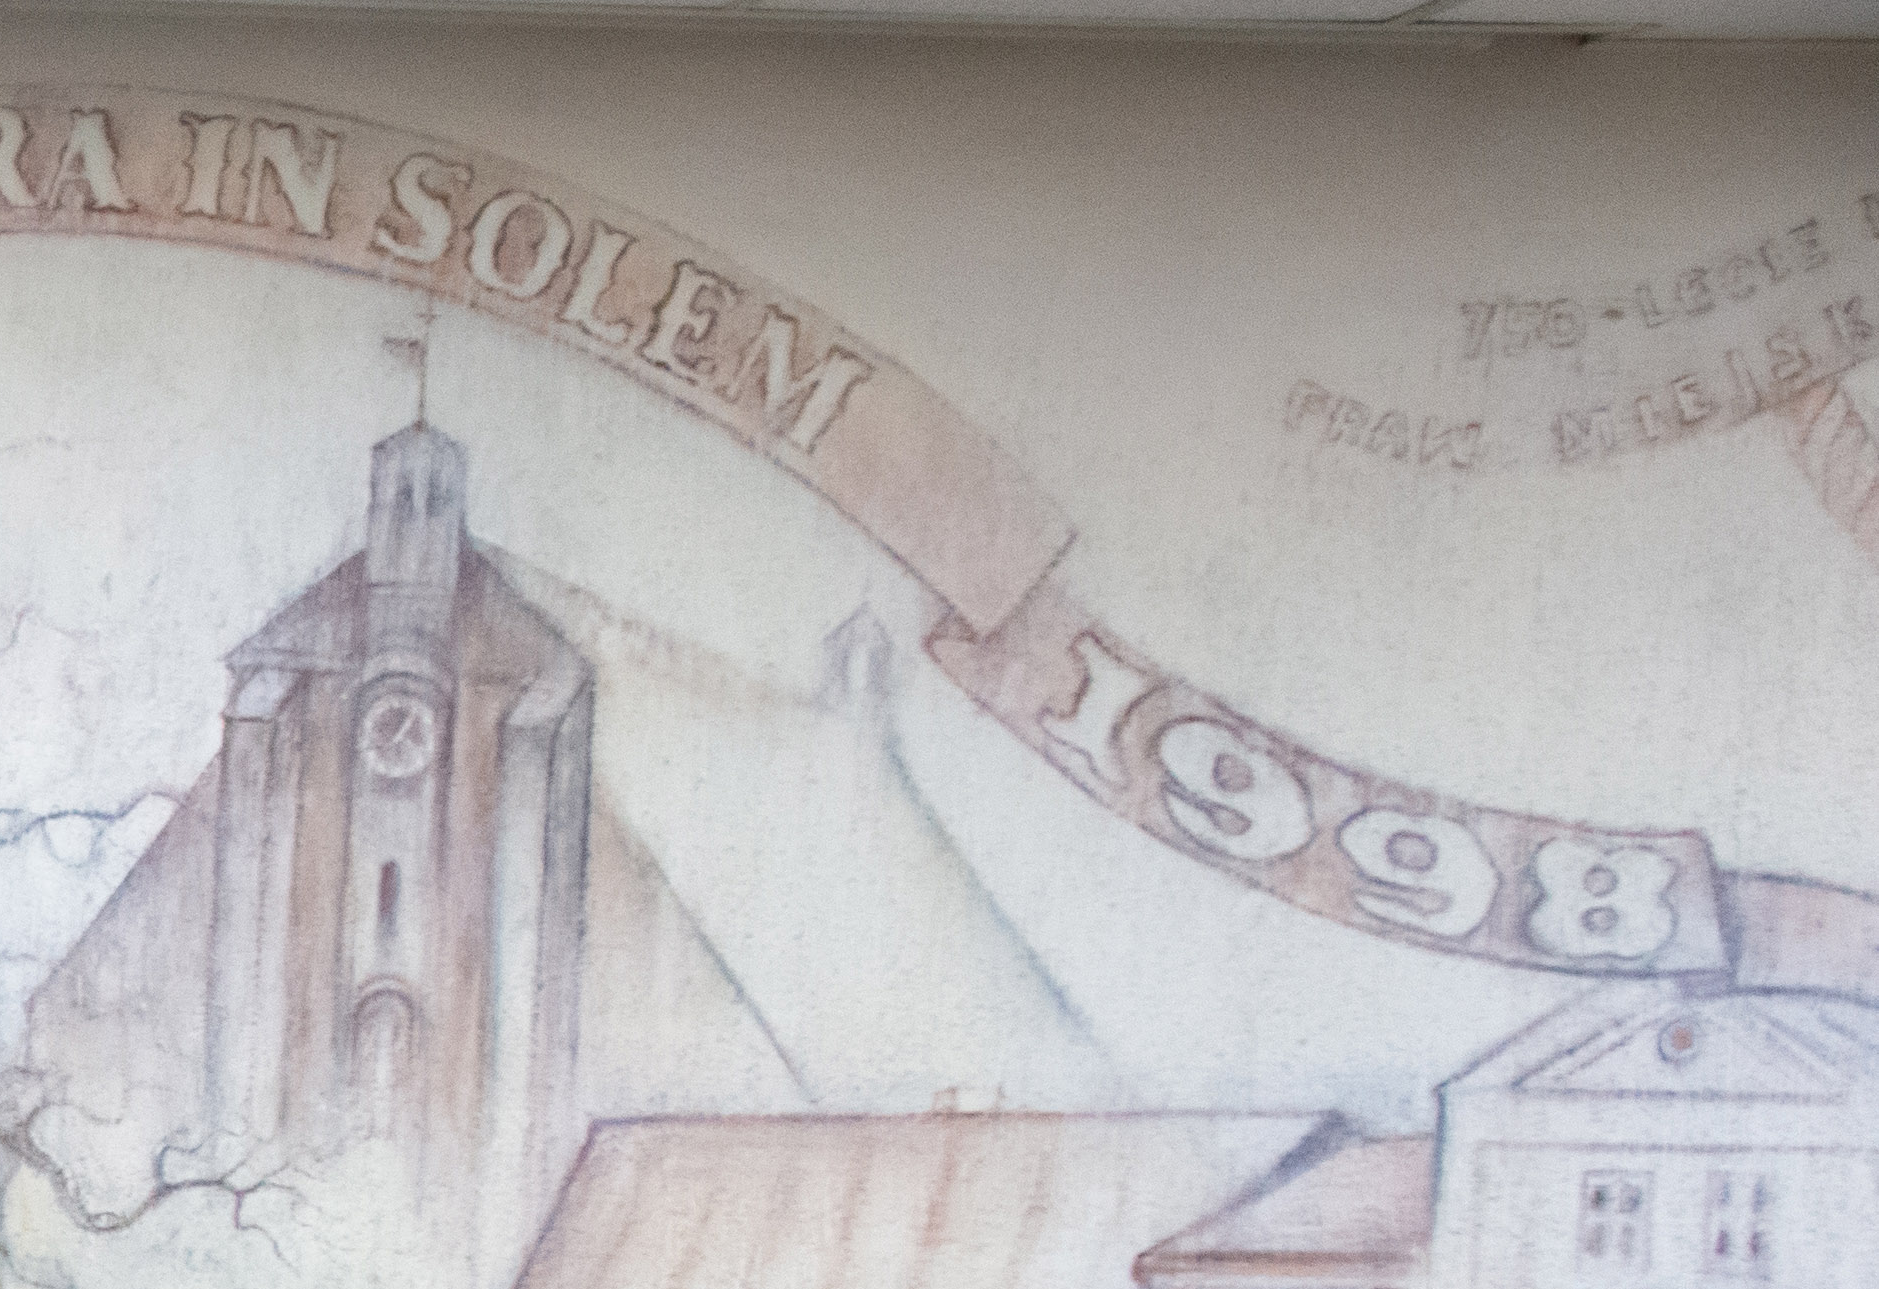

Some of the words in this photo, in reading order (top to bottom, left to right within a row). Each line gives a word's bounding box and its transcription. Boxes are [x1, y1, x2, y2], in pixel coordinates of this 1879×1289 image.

[177, 108, 342, 238] IN
[374, 150, 877, 455] SOLEM
[1040, 630, 1680, 962] 1998
